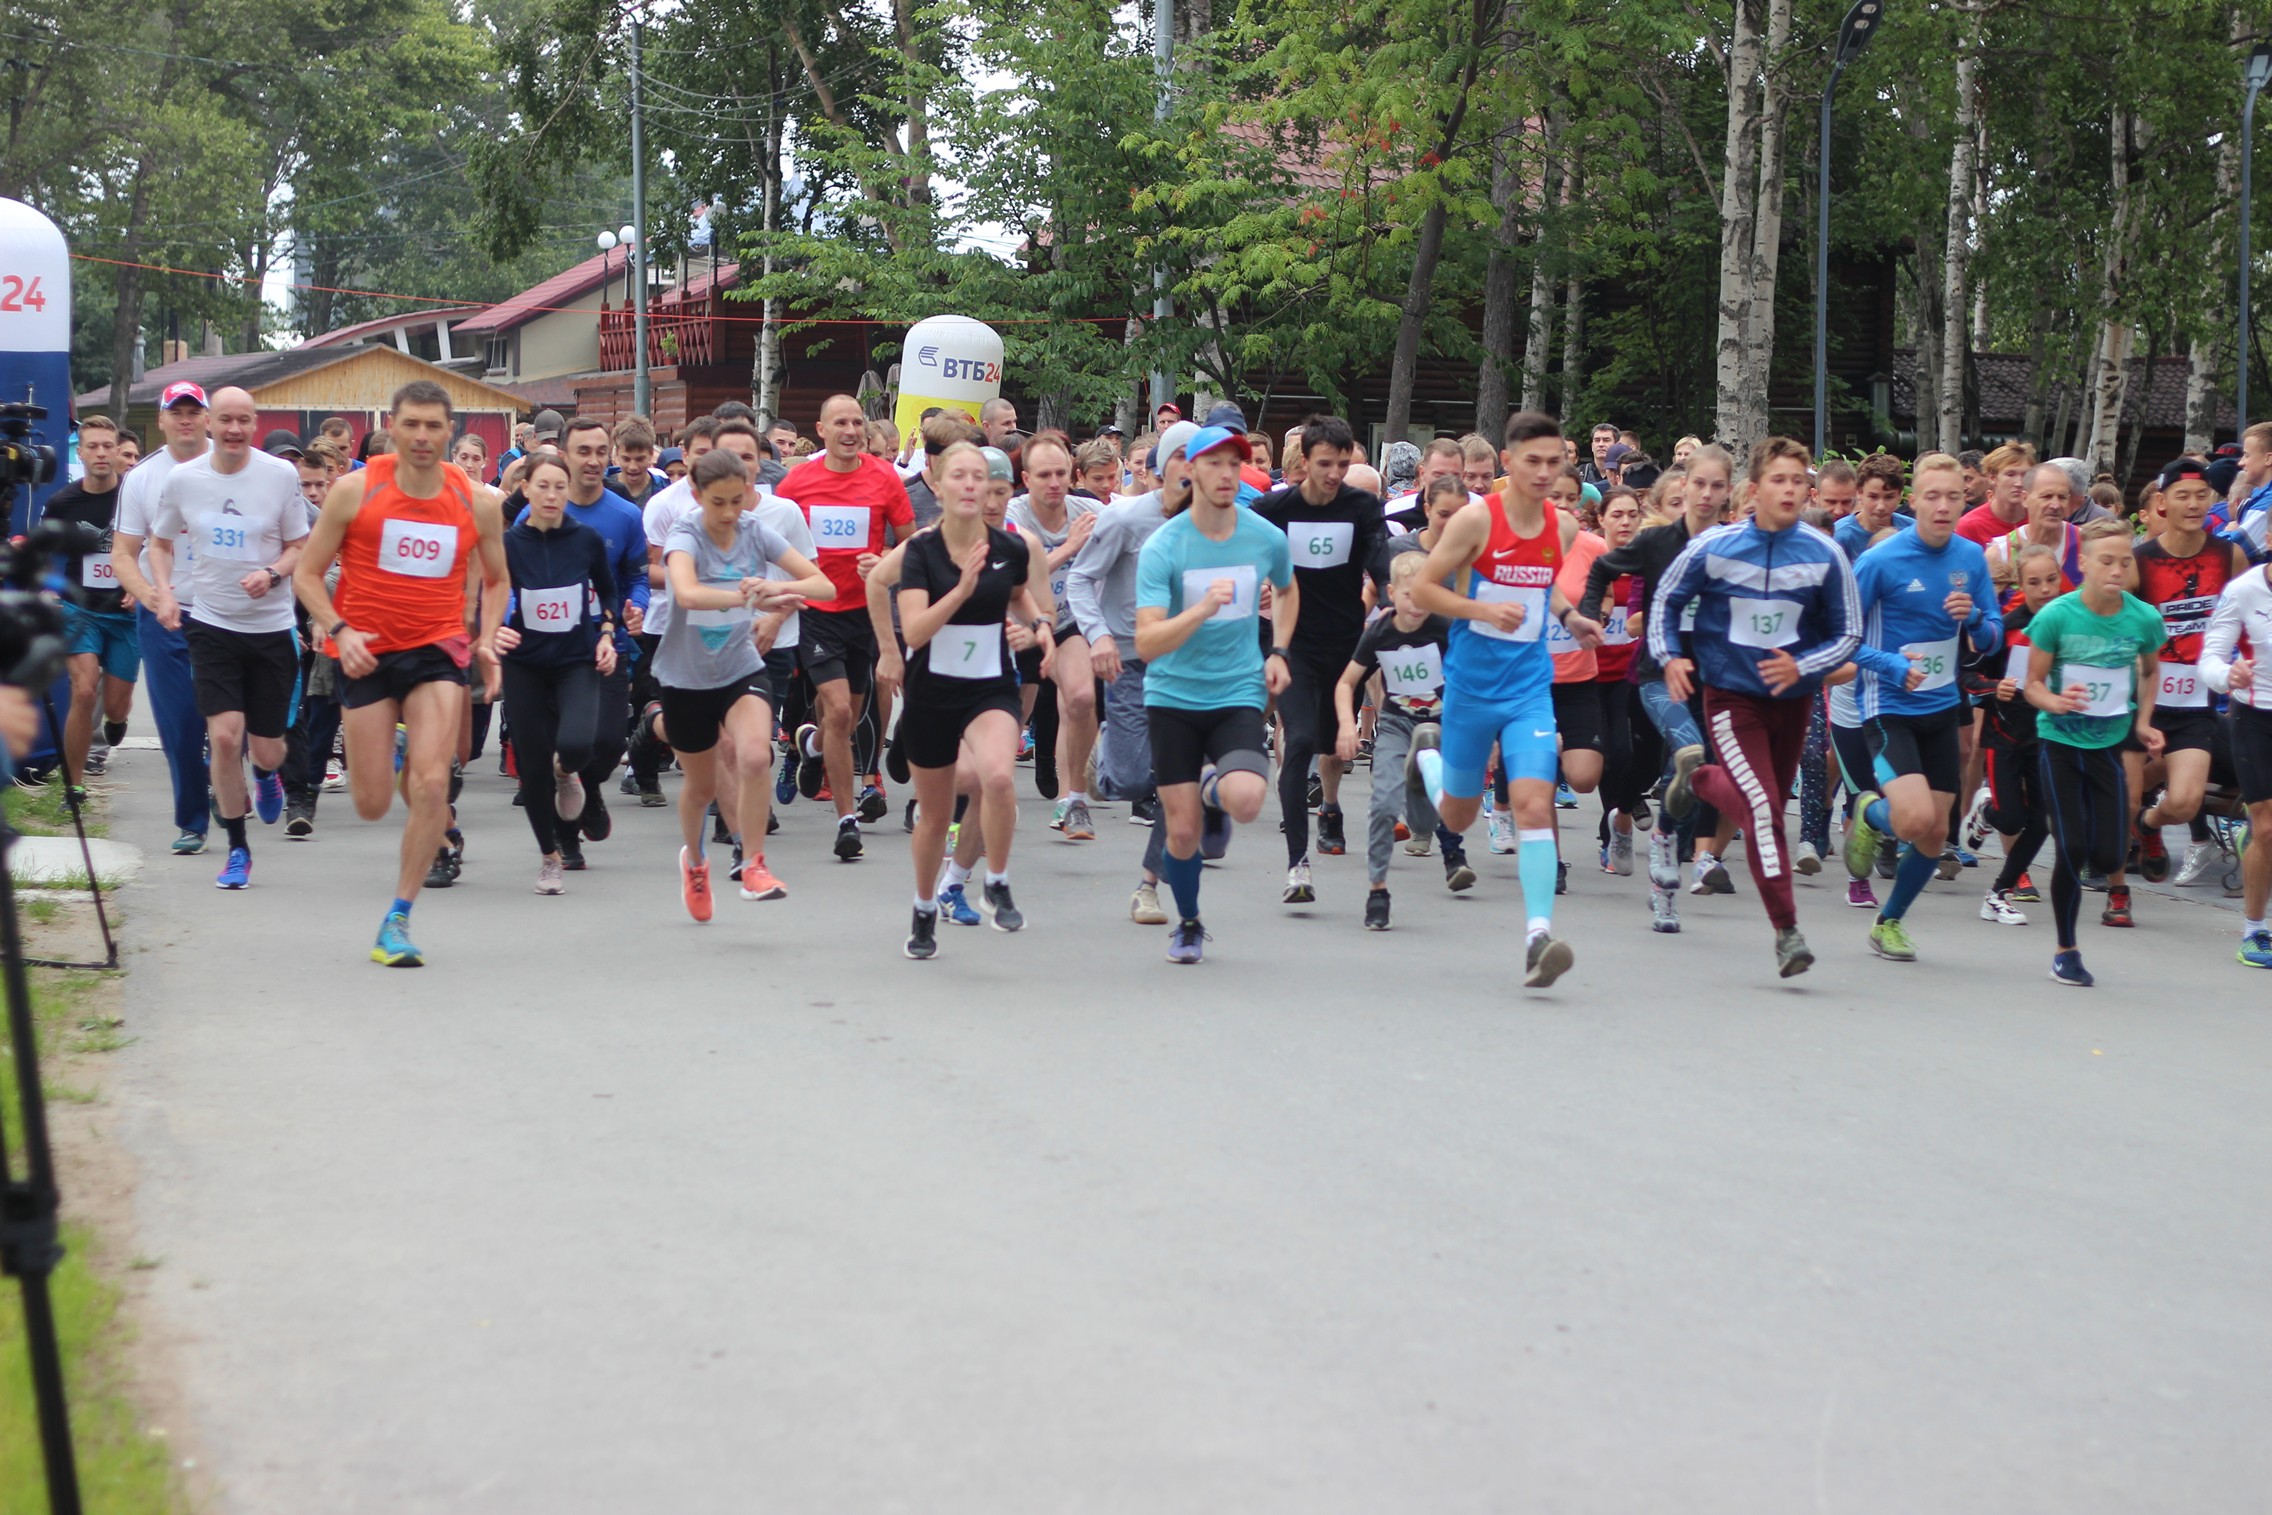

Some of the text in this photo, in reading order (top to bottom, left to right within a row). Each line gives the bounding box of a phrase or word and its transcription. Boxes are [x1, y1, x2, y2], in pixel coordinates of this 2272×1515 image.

[0, 275, 46, 312] 24
[822, 519, 856, 536] 328
[212, 527, 246, 548] 331
[1309, 537, 1333, 555] 65
[397, 536, 440, 560] 609
[93, 563, 116, 578] 50
[536, 601, 569, 620] 621
[2166, 598, 2213, 614] PRIDE
[1606, 618, 1627, 634] 21
[1751, 612, 1784, 635] 137
[2166, 621, 2207, 633] TEAM
[963, 641, 977, 662] 7
[1393, 661, 1429, 683] 146
[1921, 655, 1944, 675] 36
[2086, 681, 2112, 702] 37
[2162, 676, 2196, 695] 613
